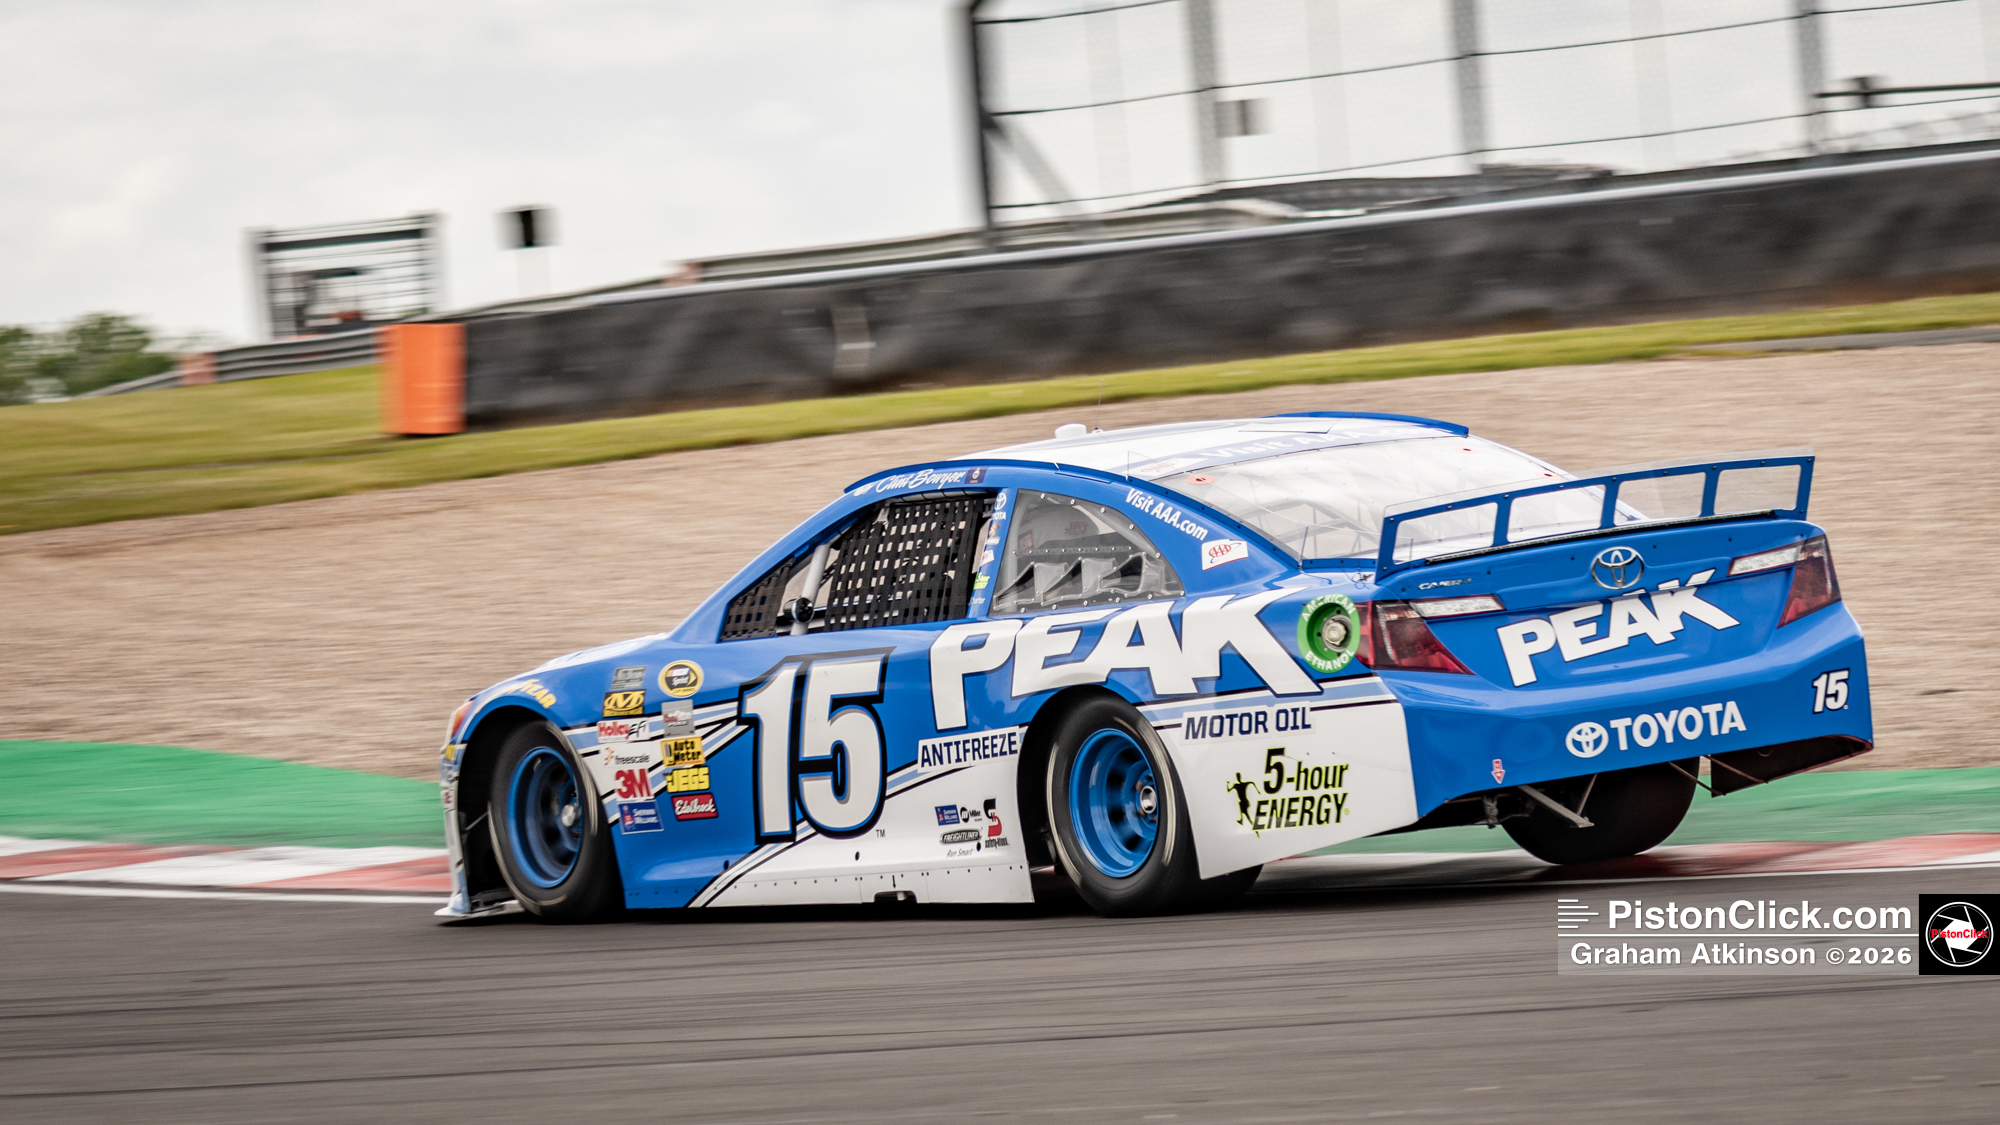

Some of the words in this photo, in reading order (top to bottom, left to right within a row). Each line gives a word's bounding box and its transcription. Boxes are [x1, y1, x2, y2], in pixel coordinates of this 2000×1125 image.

[1199, 441, 1294, 458] Visit
[876, 474, 911, 493] Clint
[908, 469, 966, 490] Bowyer
[1126, 488, 1154, 513] Visit
[1150, 502, 1208, 541] AAA.com
[1208, 544, 1232, 558] AAA
[1301, 594, 1356, 623] AMERICAN
[1496, 568, 1741, 687] PEAK
[930, 586, 1324, 731] PEAK
[1304, 649, 1355, 671] ETHANOL
[1812, 669, 1850, 714] 15
[1185, 711, 1268, 740] MOTOR
[1275, 707, 1311, 732] OIL
[1609, 700, 1747, 751] TOYOTA
[615, 754, 650, 765] freescale
[673, 740, 695, 751] Auto
[673, 750, 701, 762] Meter
[741, 654, 888, 840] 15
[921, 732, 1018, 768] ANTIFREEZE
[615, 768, 651, 799] 3M
[665, 766, 710, 793] JEGS
[1263, 747, 1349, 795] 5-hour
[674, 798, 716, 816] Edelbrock
[1252, 792, 1349, 830] ENERGY
[943, 831, 979, 843] FREIGHTLINER
[957, 848, 973, 857] Smart
